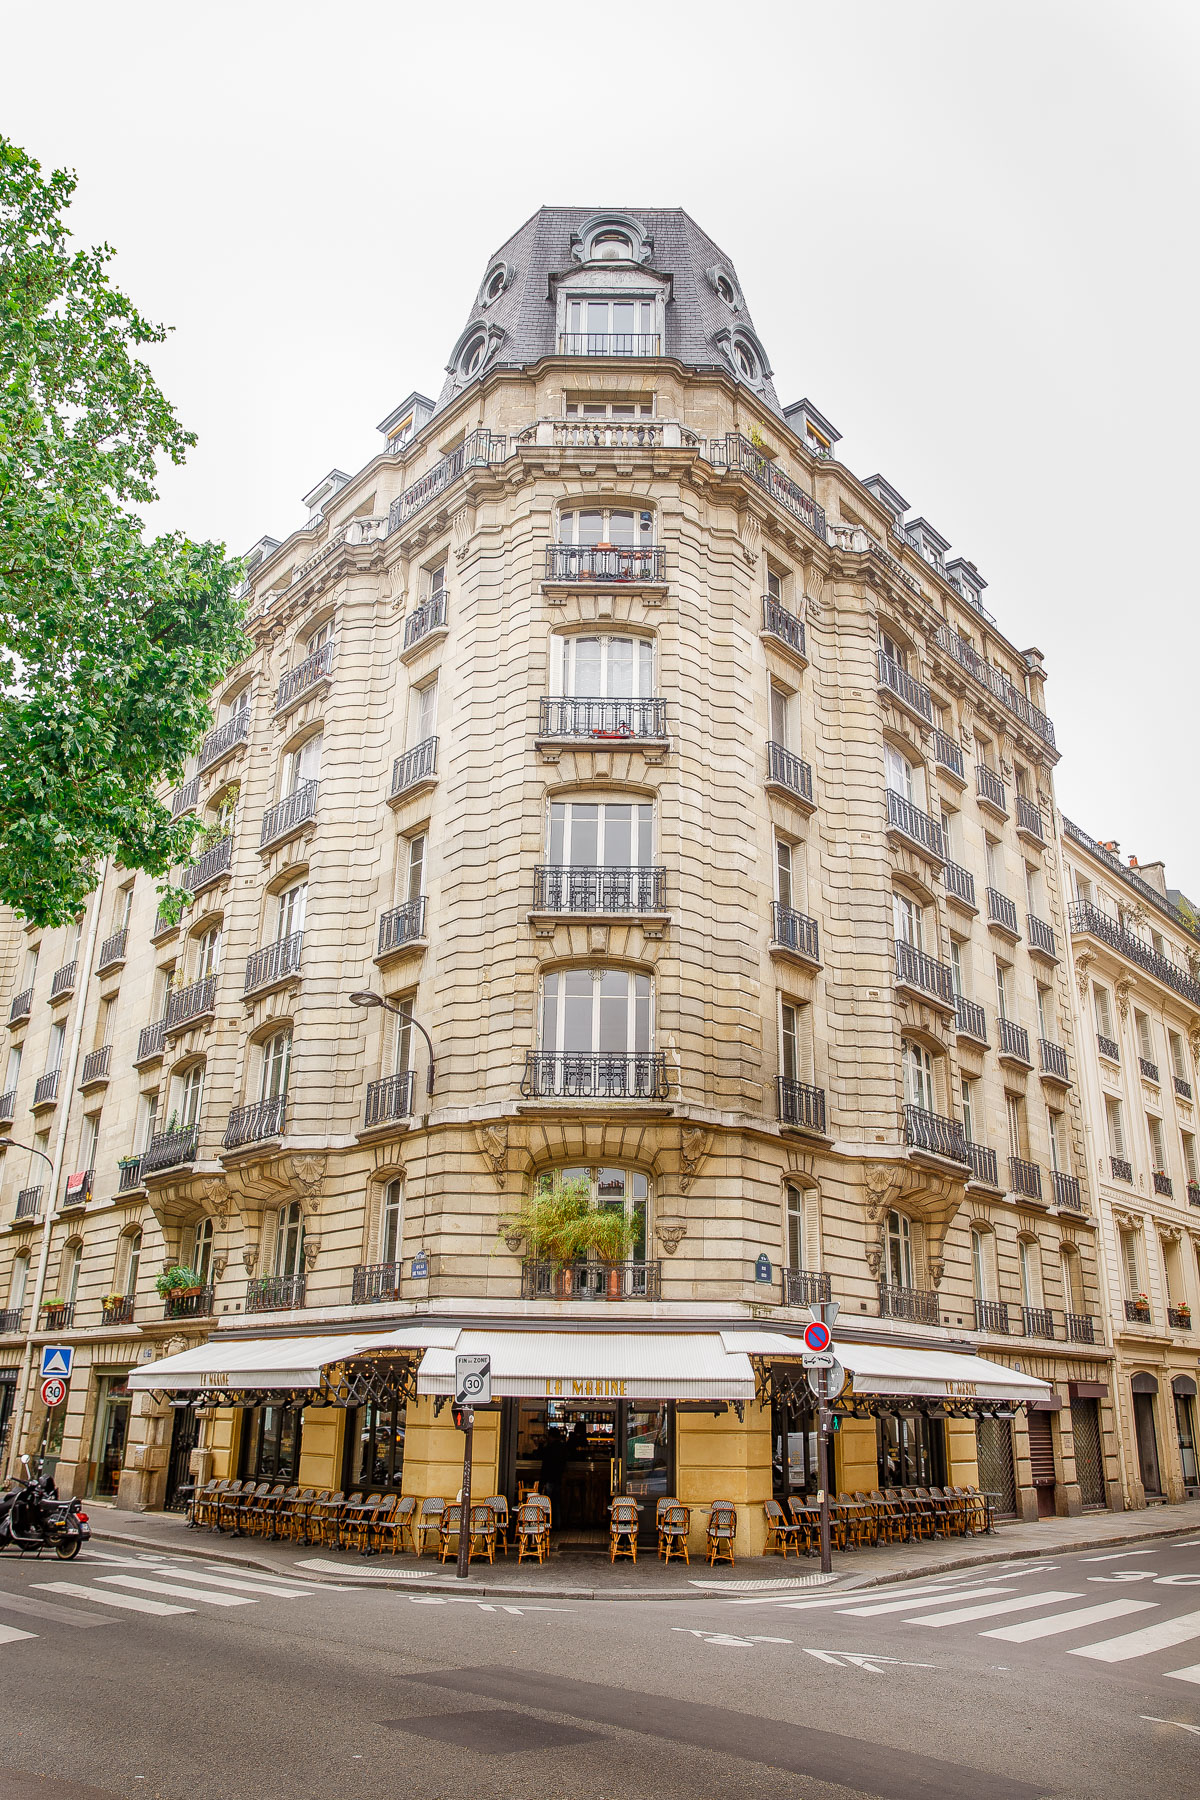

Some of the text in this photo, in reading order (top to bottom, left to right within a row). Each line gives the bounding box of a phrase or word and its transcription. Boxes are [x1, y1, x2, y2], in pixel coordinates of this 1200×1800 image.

[467, 1380, 480, 1389] 30
[546, 1380, 627, 1396] LA MARINE
[47, 1386, 60, 1398] 30
